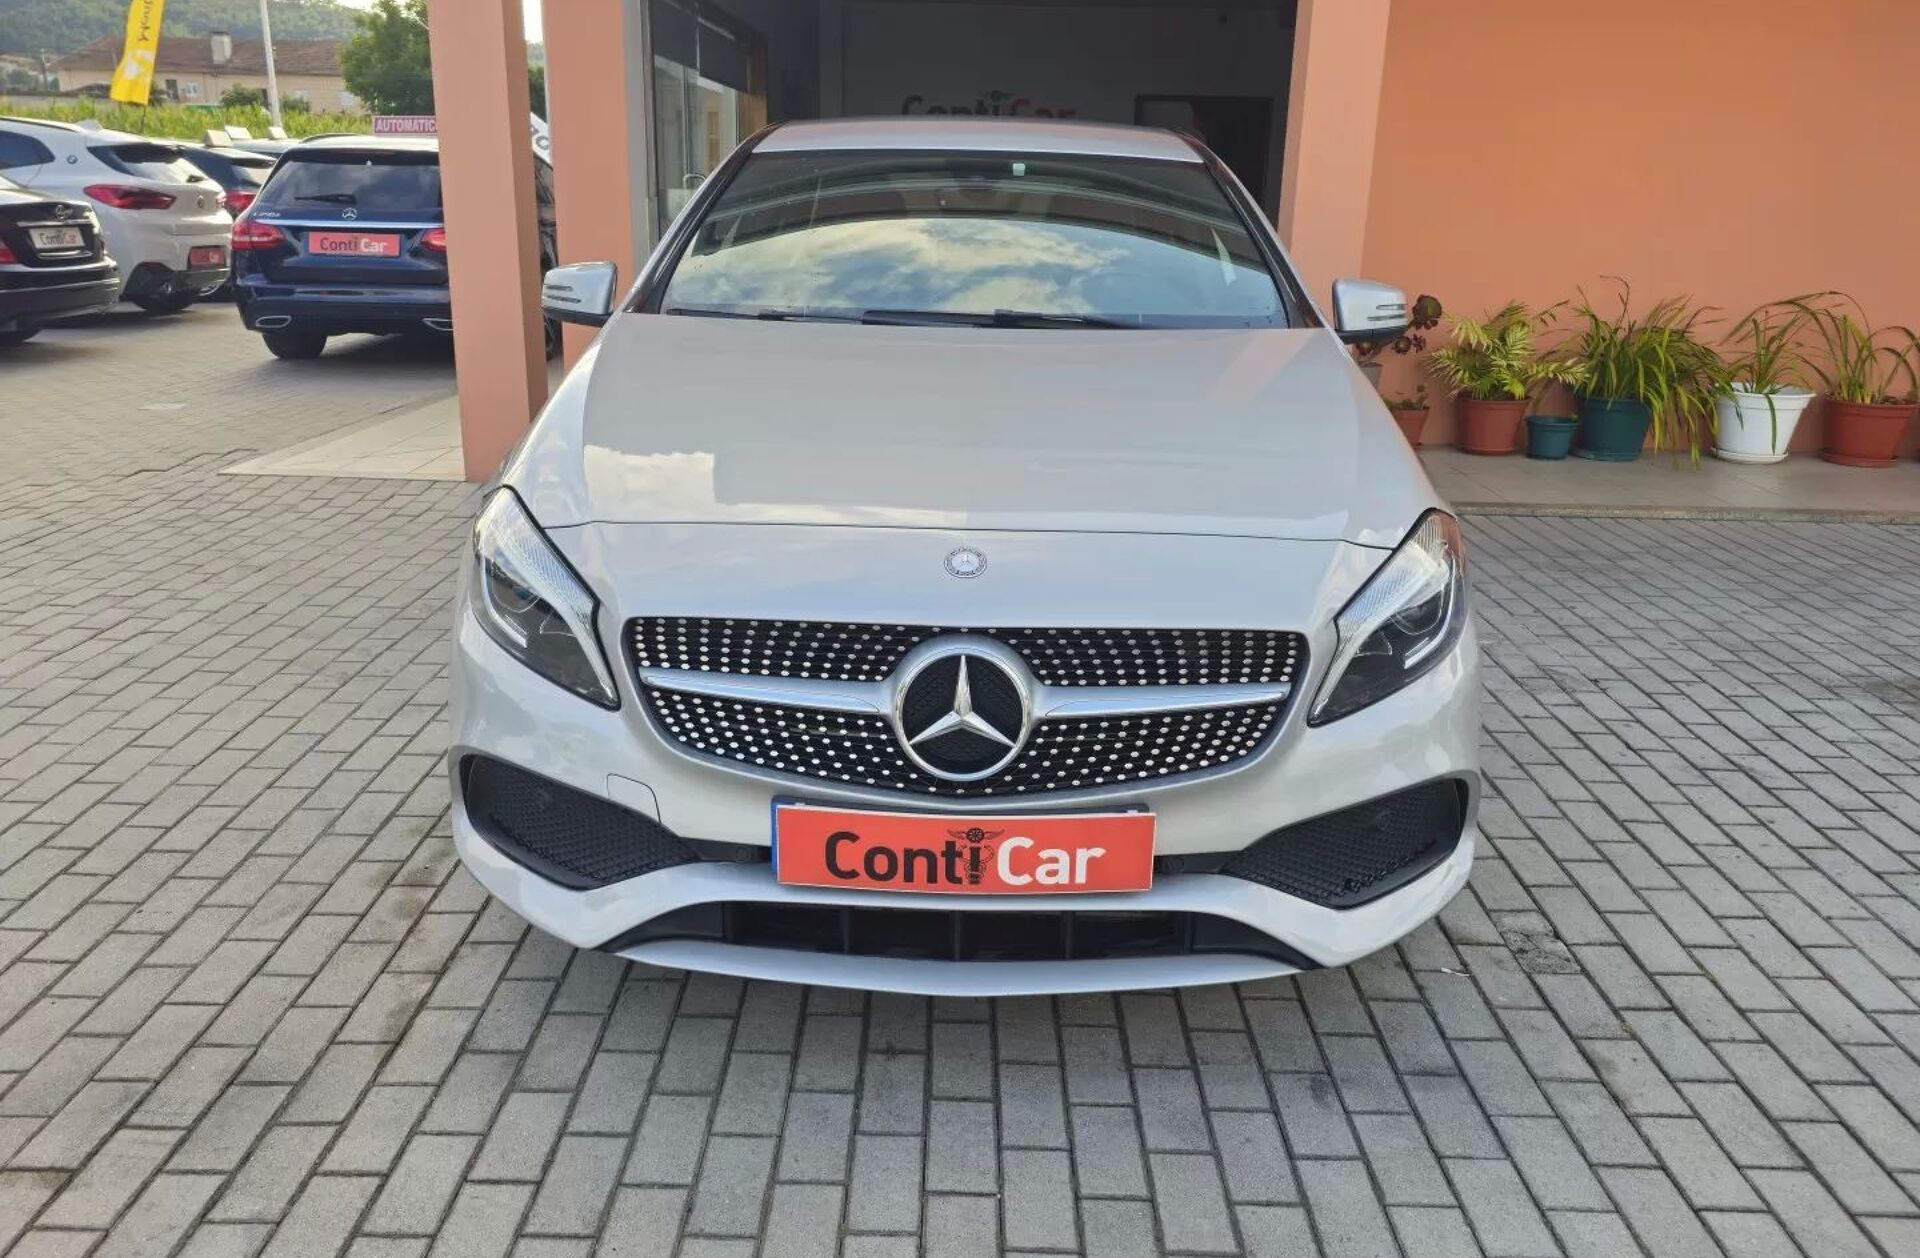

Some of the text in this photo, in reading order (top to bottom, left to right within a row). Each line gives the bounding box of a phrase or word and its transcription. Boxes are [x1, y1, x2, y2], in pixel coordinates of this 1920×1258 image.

[320, 236, 388, 253] Conti Car
[824, 828, 1107, 886] Conti Car
